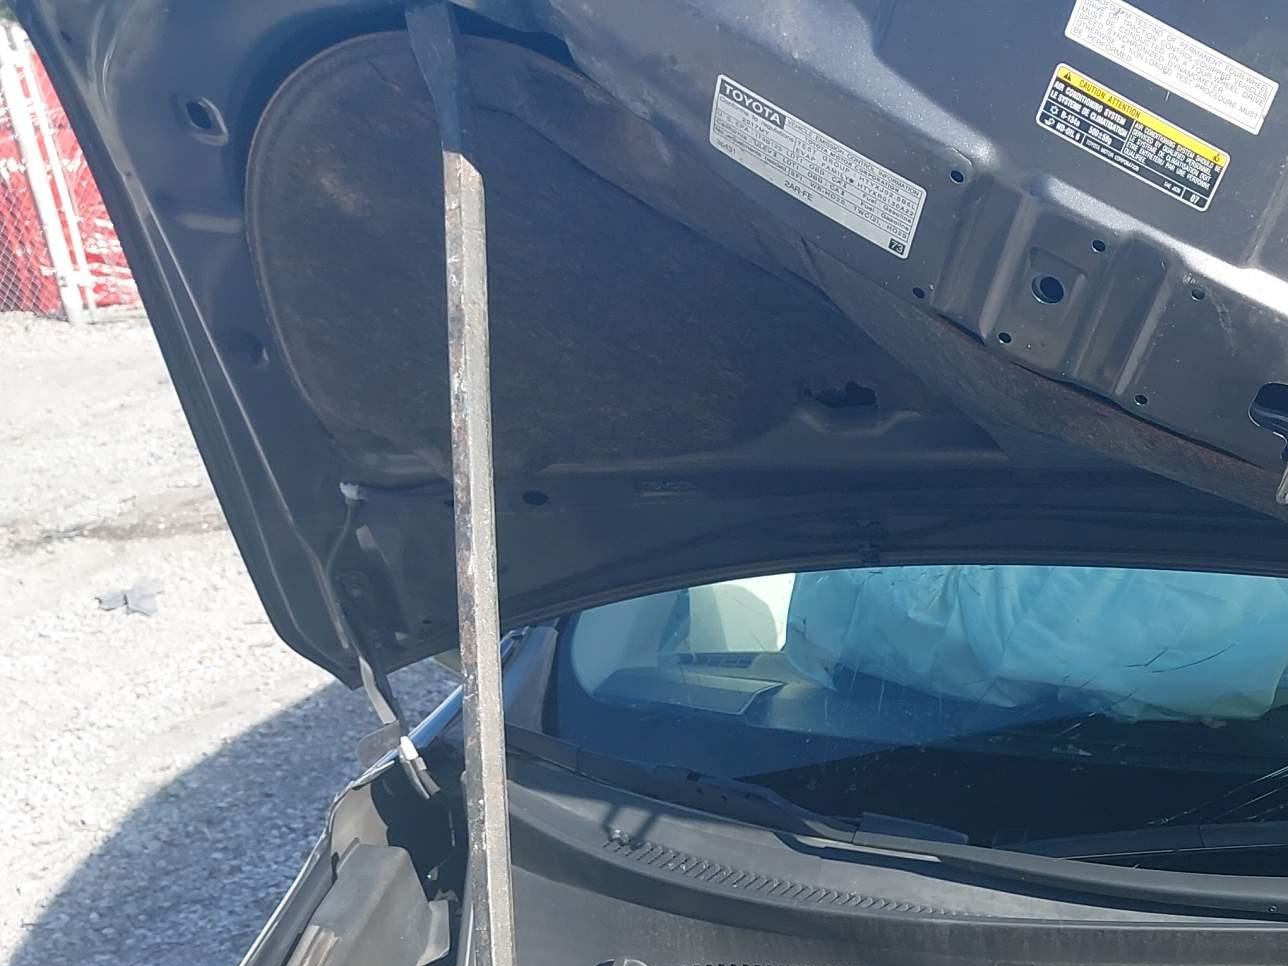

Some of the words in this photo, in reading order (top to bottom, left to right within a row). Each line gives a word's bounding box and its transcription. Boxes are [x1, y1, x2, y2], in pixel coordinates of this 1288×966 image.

[723, 83, 782, 125] TOYOTA
[1049, 89, 1058, 99] LE
[1080, 106, 1091, 117] DE
[1088, 110, 1128, 137] CLIMATISATION
[1053, 79, 1065, 92] AIR
[1064, 86, 1104, 113] CONDITIONING
[1102, 106, 1127, 125] SYSTEM
[1078, 78, 1106, 100] CAUTION
[1106, 94, 1141, 119] ATTENTION
[1134, 121, 1144, 131] AIR
[889, 238, 903, 254] 73
